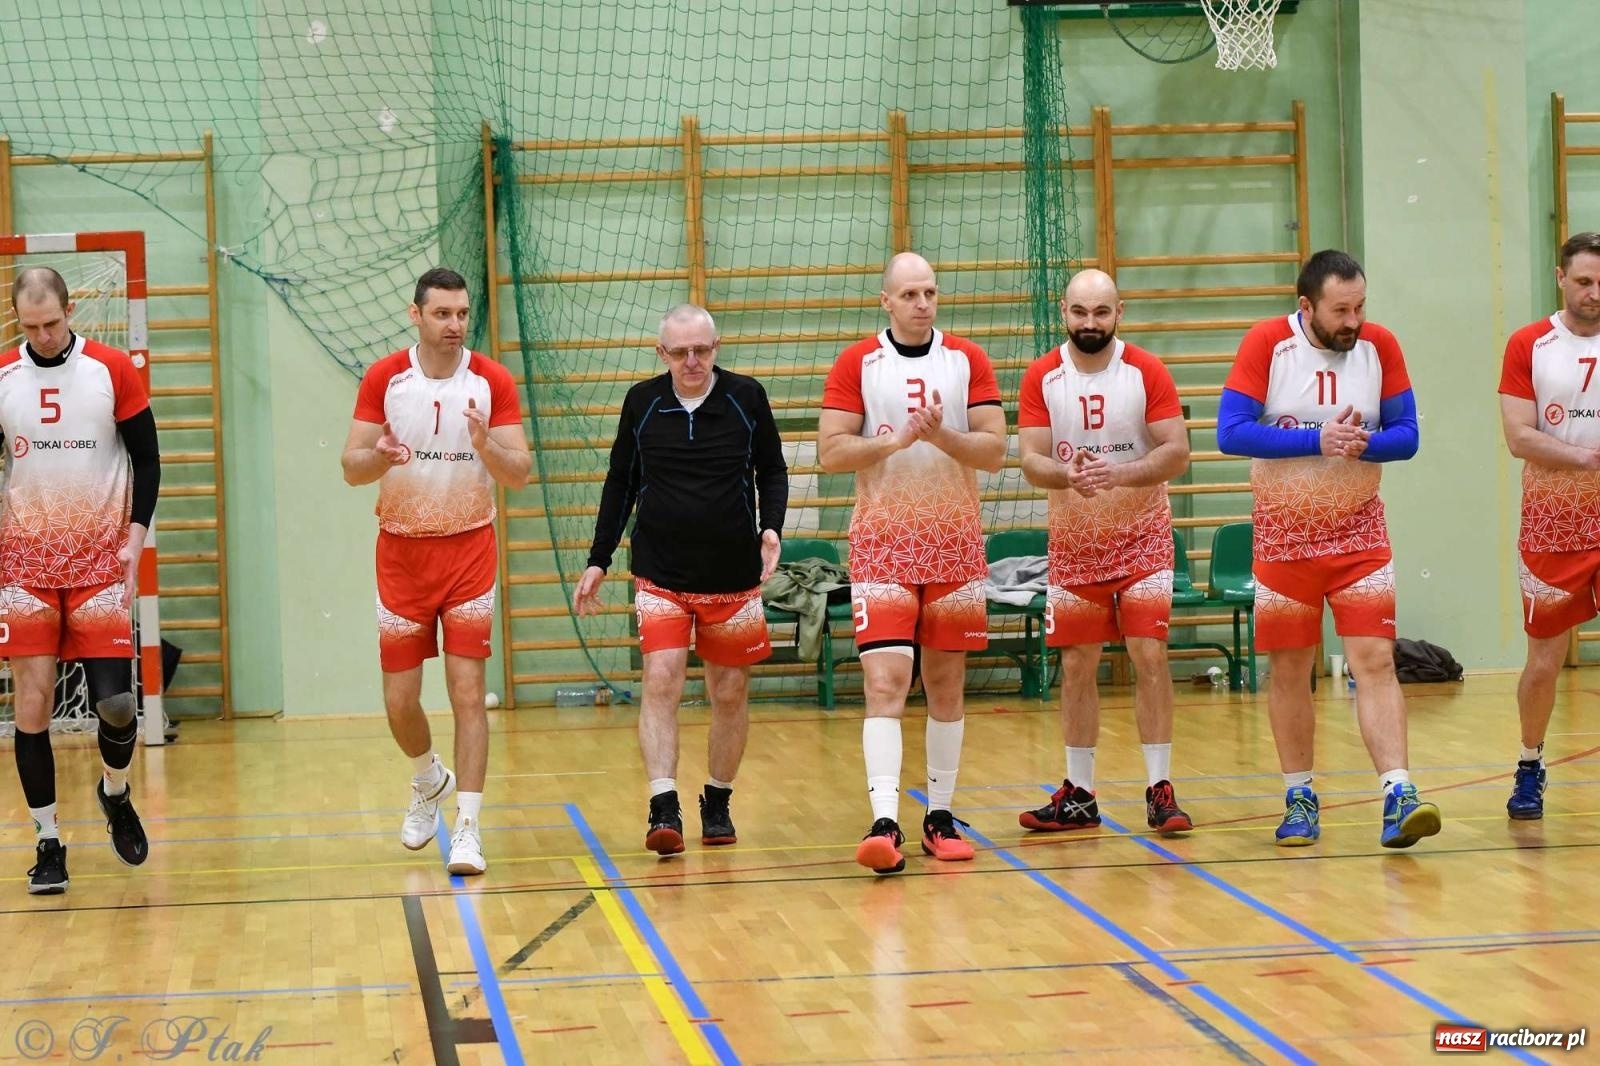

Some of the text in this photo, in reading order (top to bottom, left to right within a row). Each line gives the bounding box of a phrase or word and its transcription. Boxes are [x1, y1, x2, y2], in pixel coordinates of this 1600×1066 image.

[1315, 370, 1337, 406] 11
[1578, 357, 1598, 393] 7
[40, 388, 61, 424] 5
[906, 378, 927, 414] 3
[1078, 394, 1105, 431] 13
[1567, 409, 1595, 418] TOKAI
[433, 401, 441, 435] 1
[32, 440, 97, 450] TOKAI COBEX
[415, 450, 474, 462] TOKAI COBEX
[1102, 442, 1134, 454] COBEX
[854, 597, 869, 633] 3
